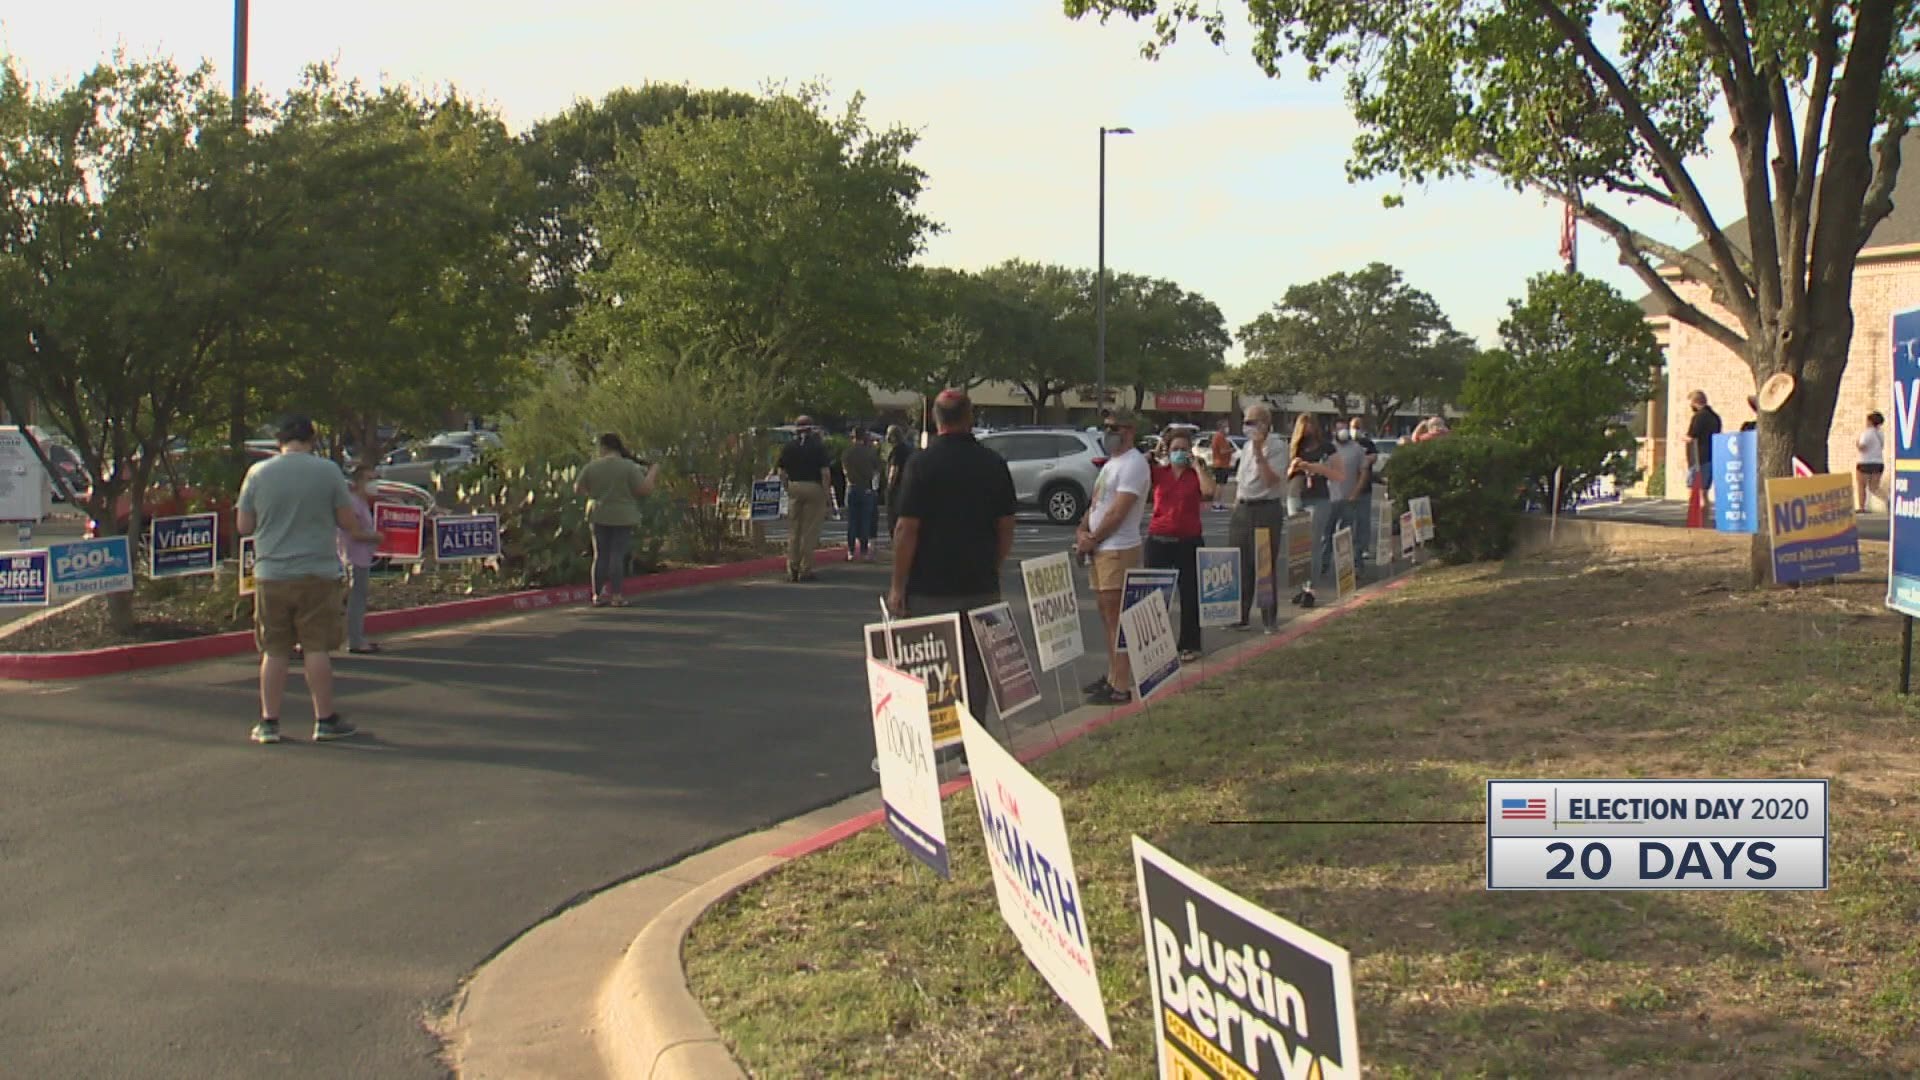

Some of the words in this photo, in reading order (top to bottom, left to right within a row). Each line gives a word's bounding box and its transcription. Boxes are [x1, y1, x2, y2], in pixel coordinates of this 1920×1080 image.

[1774, 498, 1806, 536] NO
[158, 527, 211, 549] Virden
[442, 530, 493, 549] ALTER
[0, 568, 43, 589] SIEGEL
[56, 546, 114, 578] POOL
[1026, 561, 1071, 599] ROBERT
[1032, 591, 1076, 626] THOMAS
[1131, 595, 1166, 651] JULIE
[895, 632, 947, 666] Justin
[975, 779, 1085, 948] McMATH
[1184, 900, 1309, 1038] Justin
